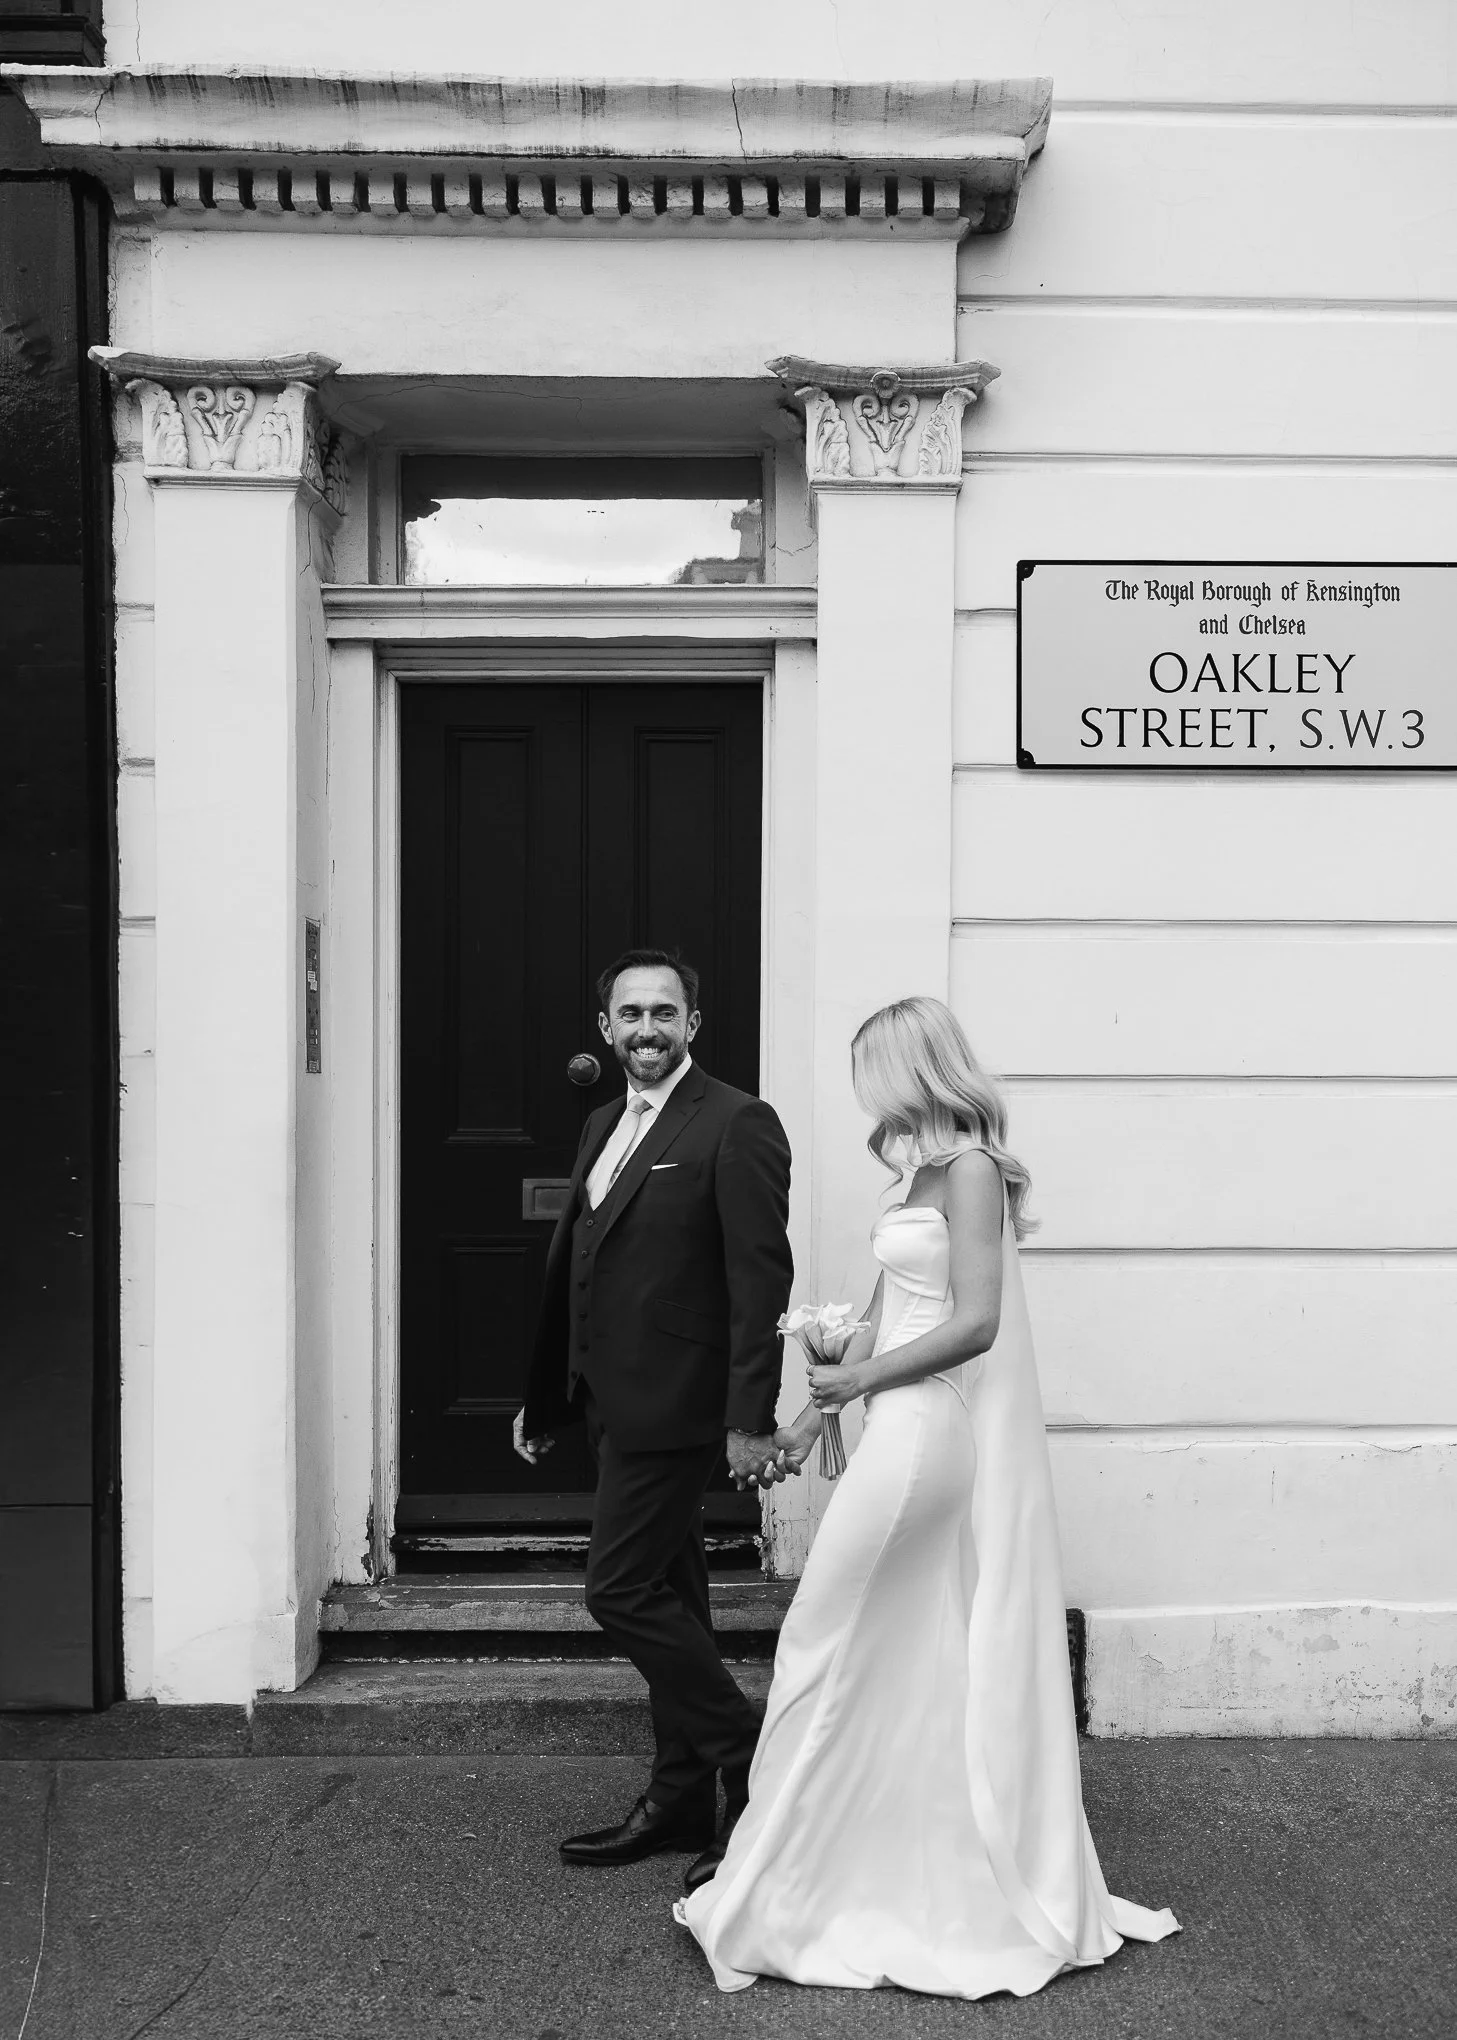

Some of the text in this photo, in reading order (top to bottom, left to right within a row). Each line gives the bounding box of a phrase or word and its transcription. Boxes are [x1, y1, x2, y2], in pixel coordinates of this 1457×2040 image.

[1105, 579, 1401, 609] The Royal Borough of Kensington
[1199, 613, 1306, 636] and Chelsea
[1149, 651, 1356, 694] OAKLEY
[1080, 707, 1426, 753] STREET, S.W.3
